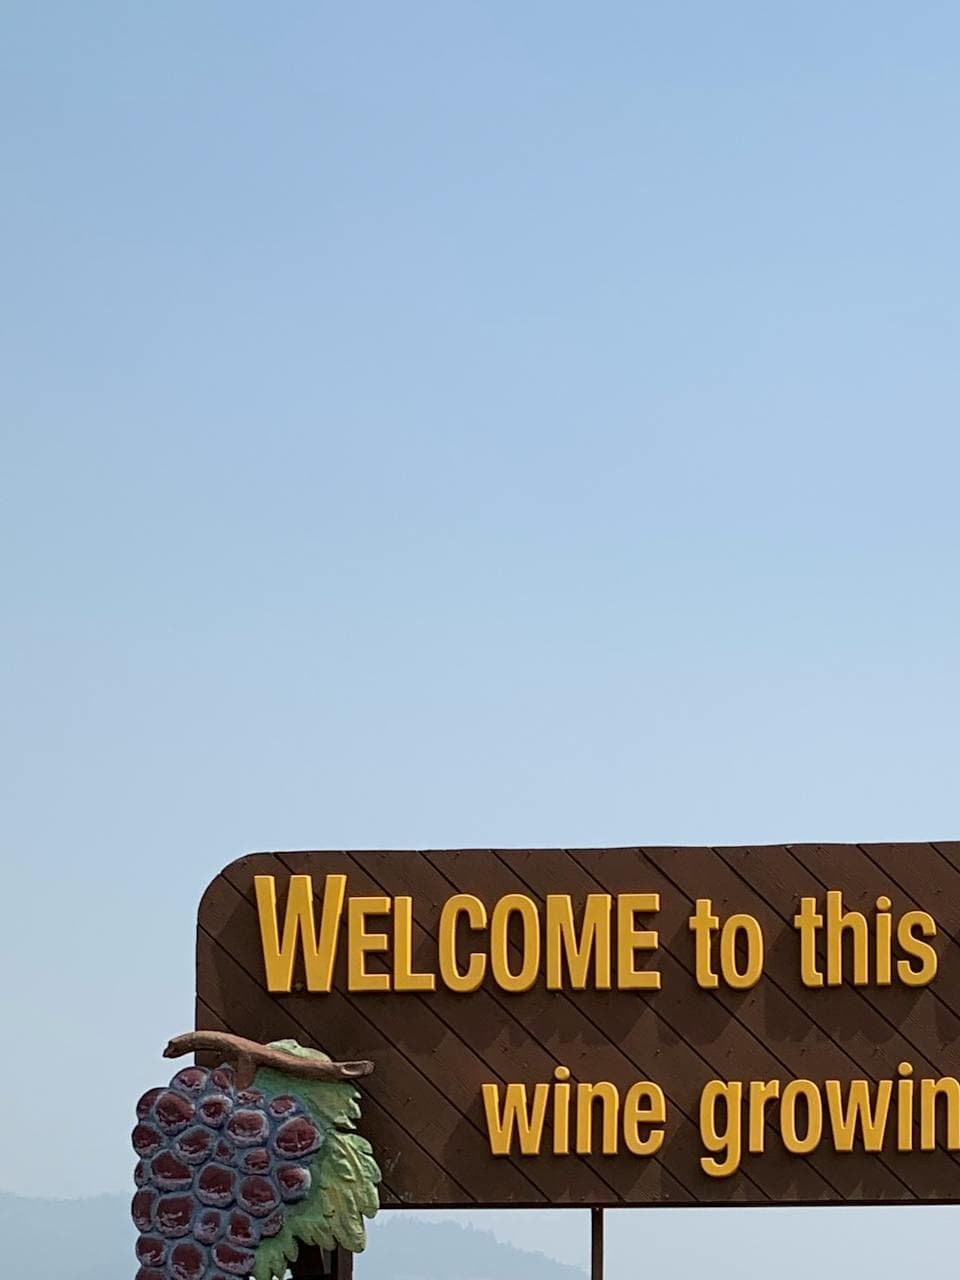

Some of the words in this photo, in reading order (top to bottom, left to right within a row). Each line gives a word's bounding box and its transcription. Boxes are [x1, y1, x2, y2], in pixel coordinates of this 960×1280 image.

[254, 873, 661, 993] WELCOME
[688, 898, 764, 989] to
[794, 889, 939, 988] this
[481, 1066, 667, 1156] wine
